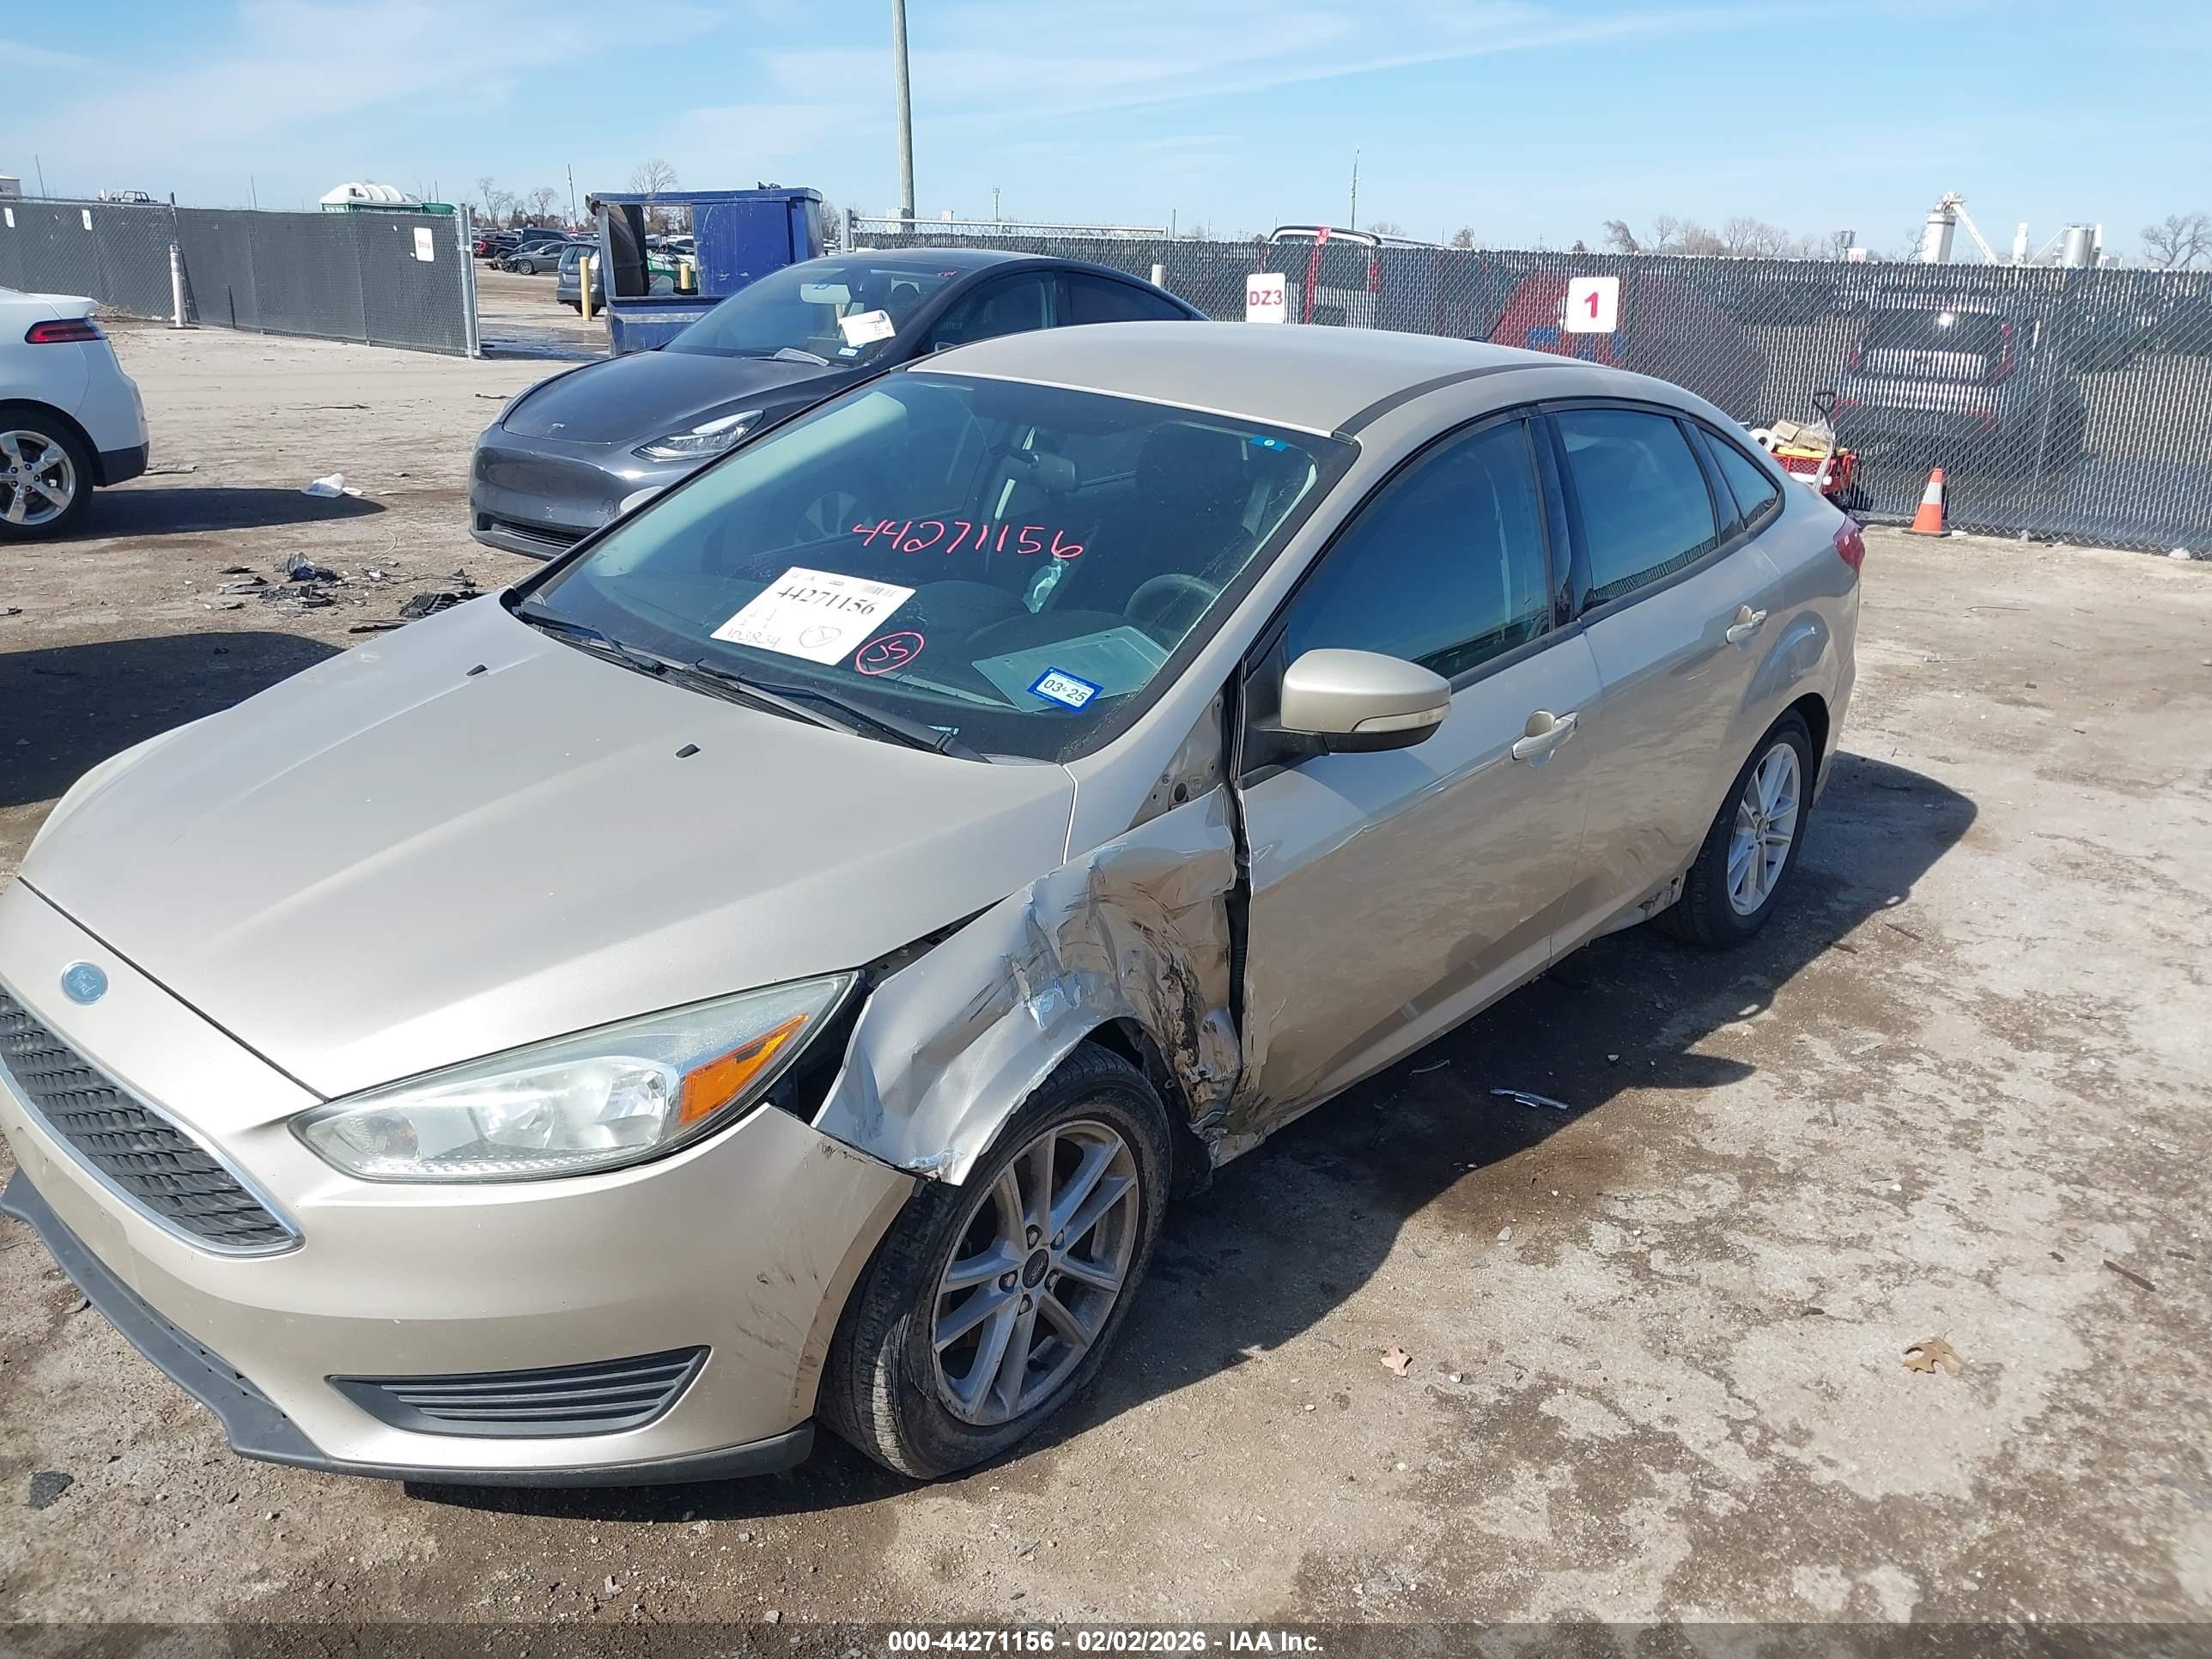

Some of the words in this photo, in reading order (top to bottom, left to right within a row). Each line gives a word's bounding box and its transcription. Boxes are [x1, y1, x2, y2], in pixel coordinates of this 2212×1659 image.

[1249, 289, 1284, 306] DZ3
[1583, 291, 1600, 319] 1
[852, 519, 1084, 558] 44271156
[776, 585, 879, 616] 44271156
